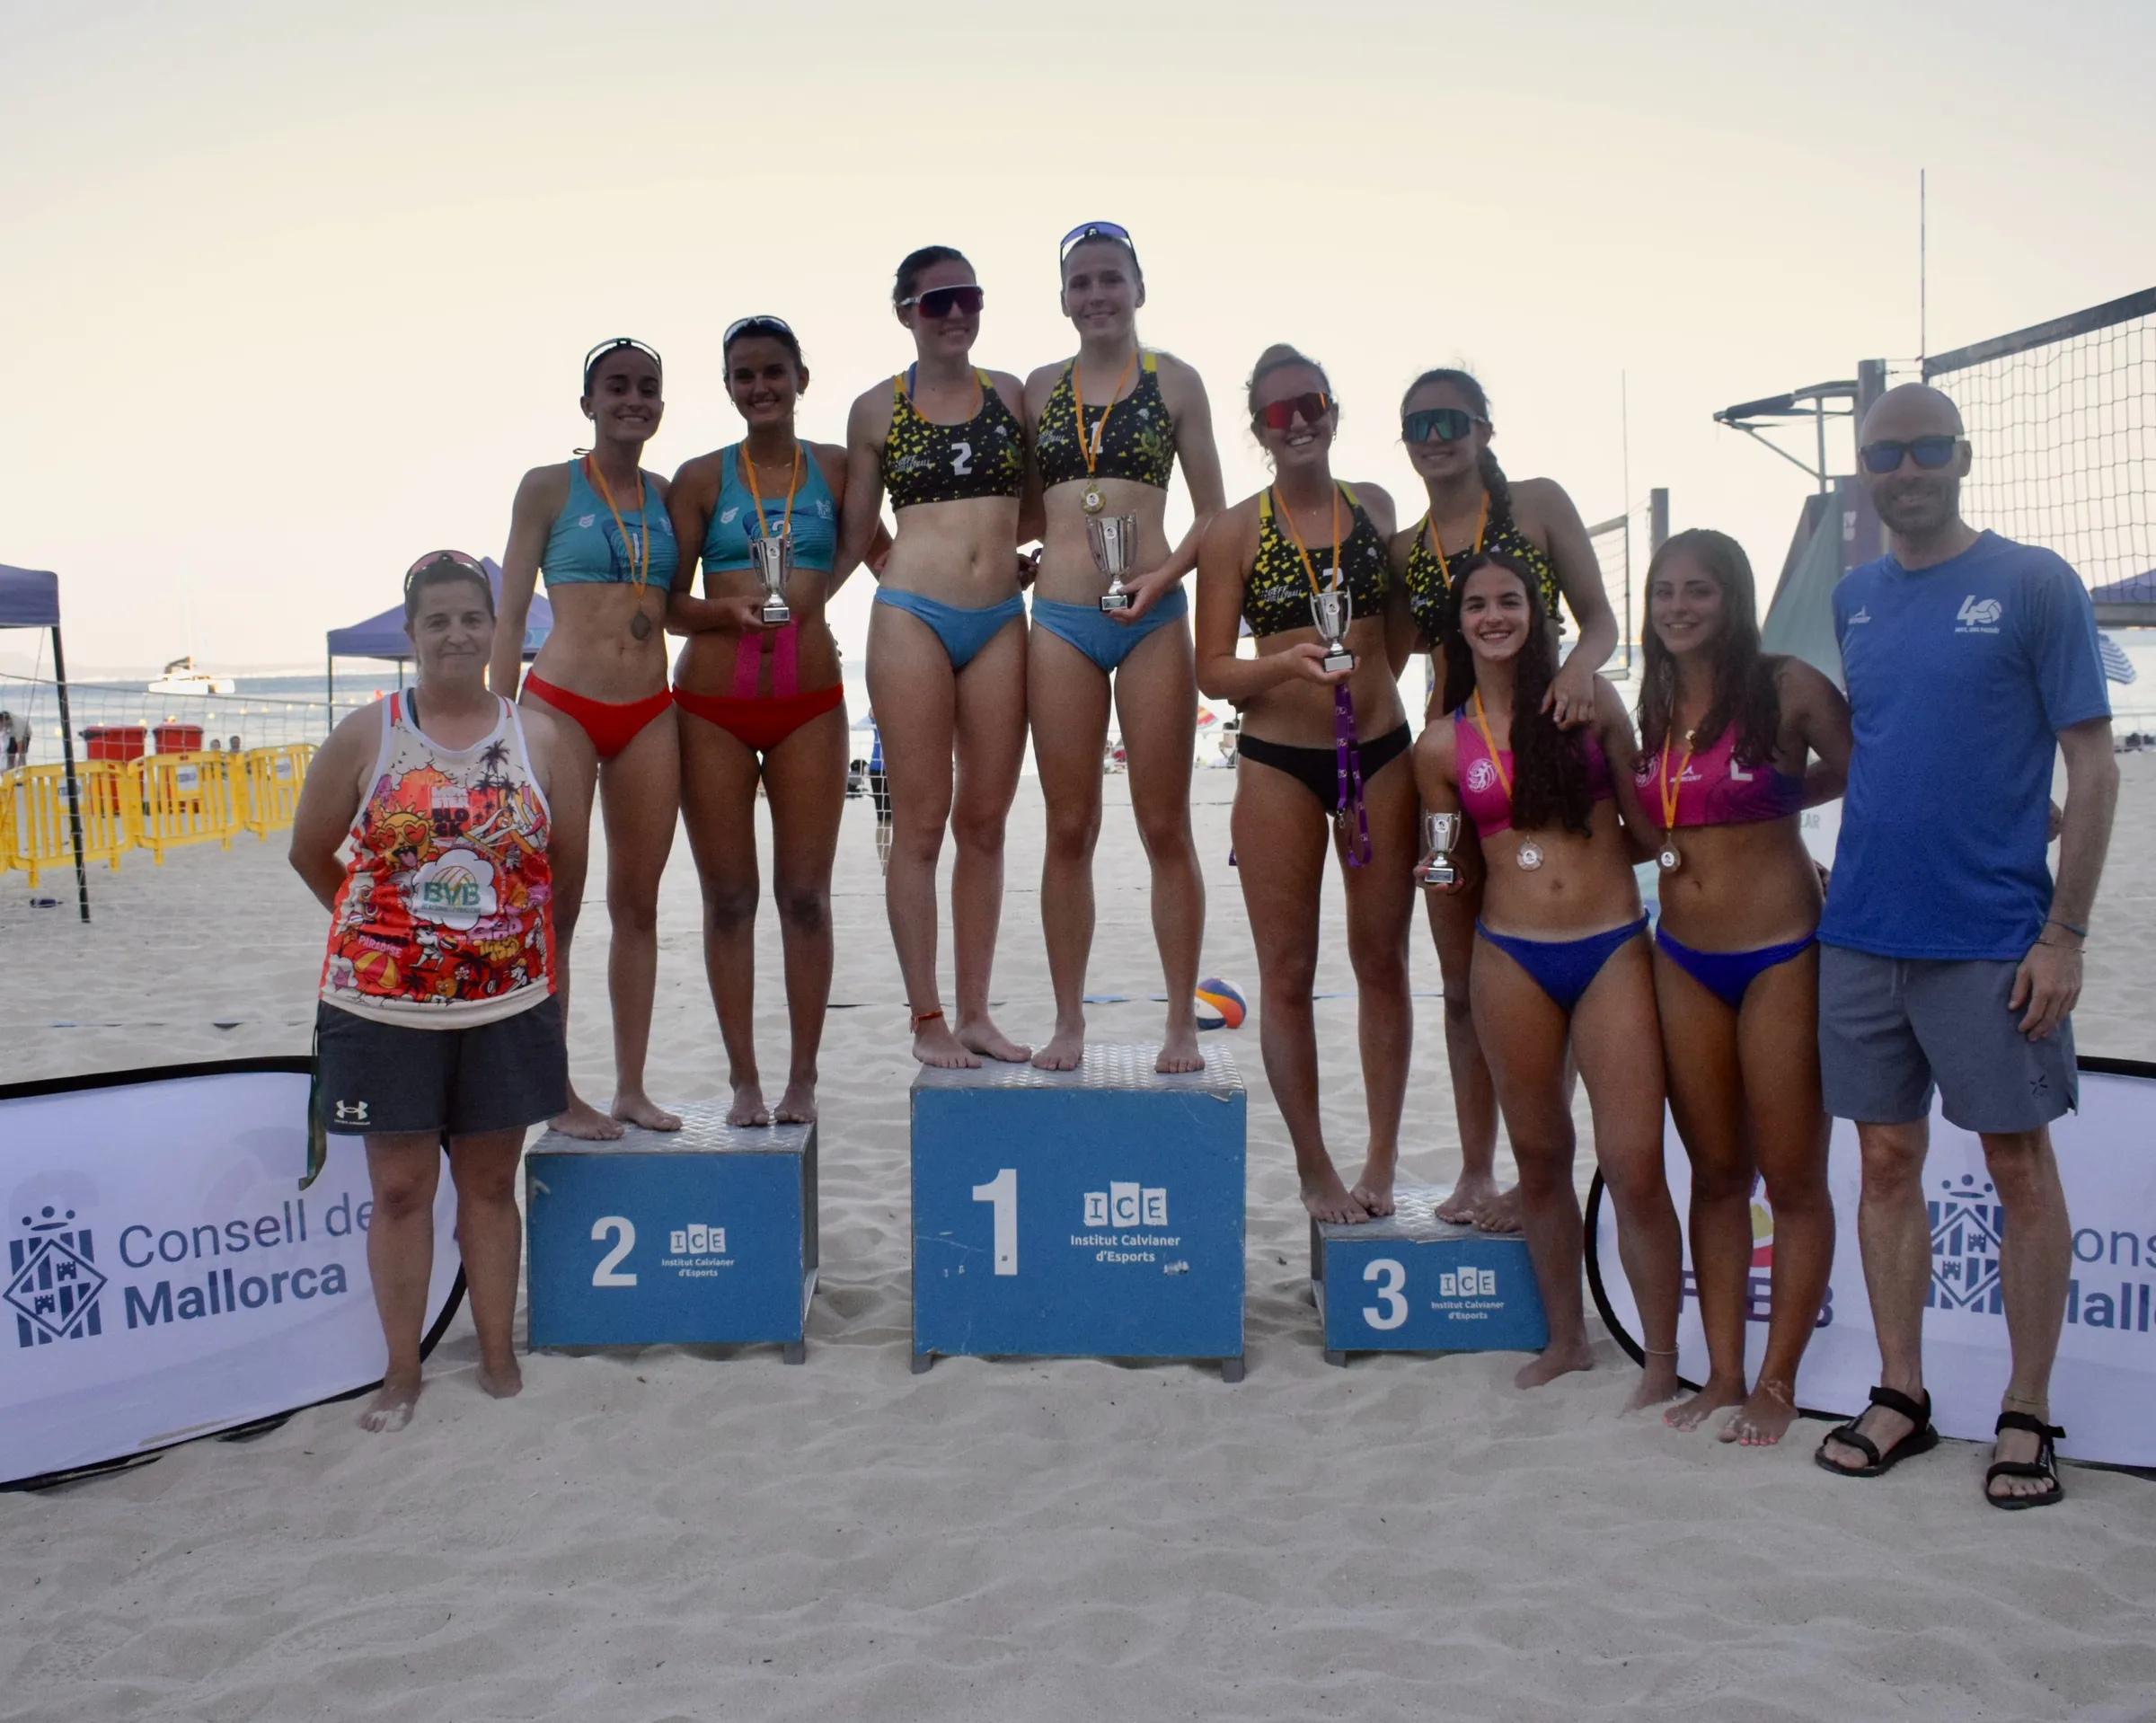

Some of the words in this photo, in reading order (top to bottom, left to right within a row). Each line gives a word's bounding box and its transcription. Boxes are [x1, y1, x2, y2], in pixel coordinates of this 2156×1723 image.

[1089, 421, 1103, 454] 1
[951, 442, 972, 475] 2
[424, 882, 481, 906] BVB
[358, 934, 402, 959] PARADISE
[1087, 1190, 1163, 1223] ICE
[119, 1197, 306, 1268] Consell
[972, 1169, 1017, 1276] 1
[591, 1215, 637, 1286] 2
[672, 1229, 723, 1251] ICE
[1070, 1233, 1118, 1247] Institut
[1120, 1233, 1181, 1247] Calvianer
[661, 1258, 694, 1267] Institut
[694, 1258, 735, 1268] Calvianer
[1095, 1250, 1156, 1263] d'Esports
[678, 1268, 719, 1278] d'Esports
[1442, 1272, 1493, 1294] ICE
[124, 1263, 349, 1330] Mallorca
[1363, 1259, 1409, 1330] 3
[1431, 1302, 1464, 1310] Institut
[1464, 1301, 1505, 1310] Calvianer
[1448, 1312, 1488, 1321] d'Esports
